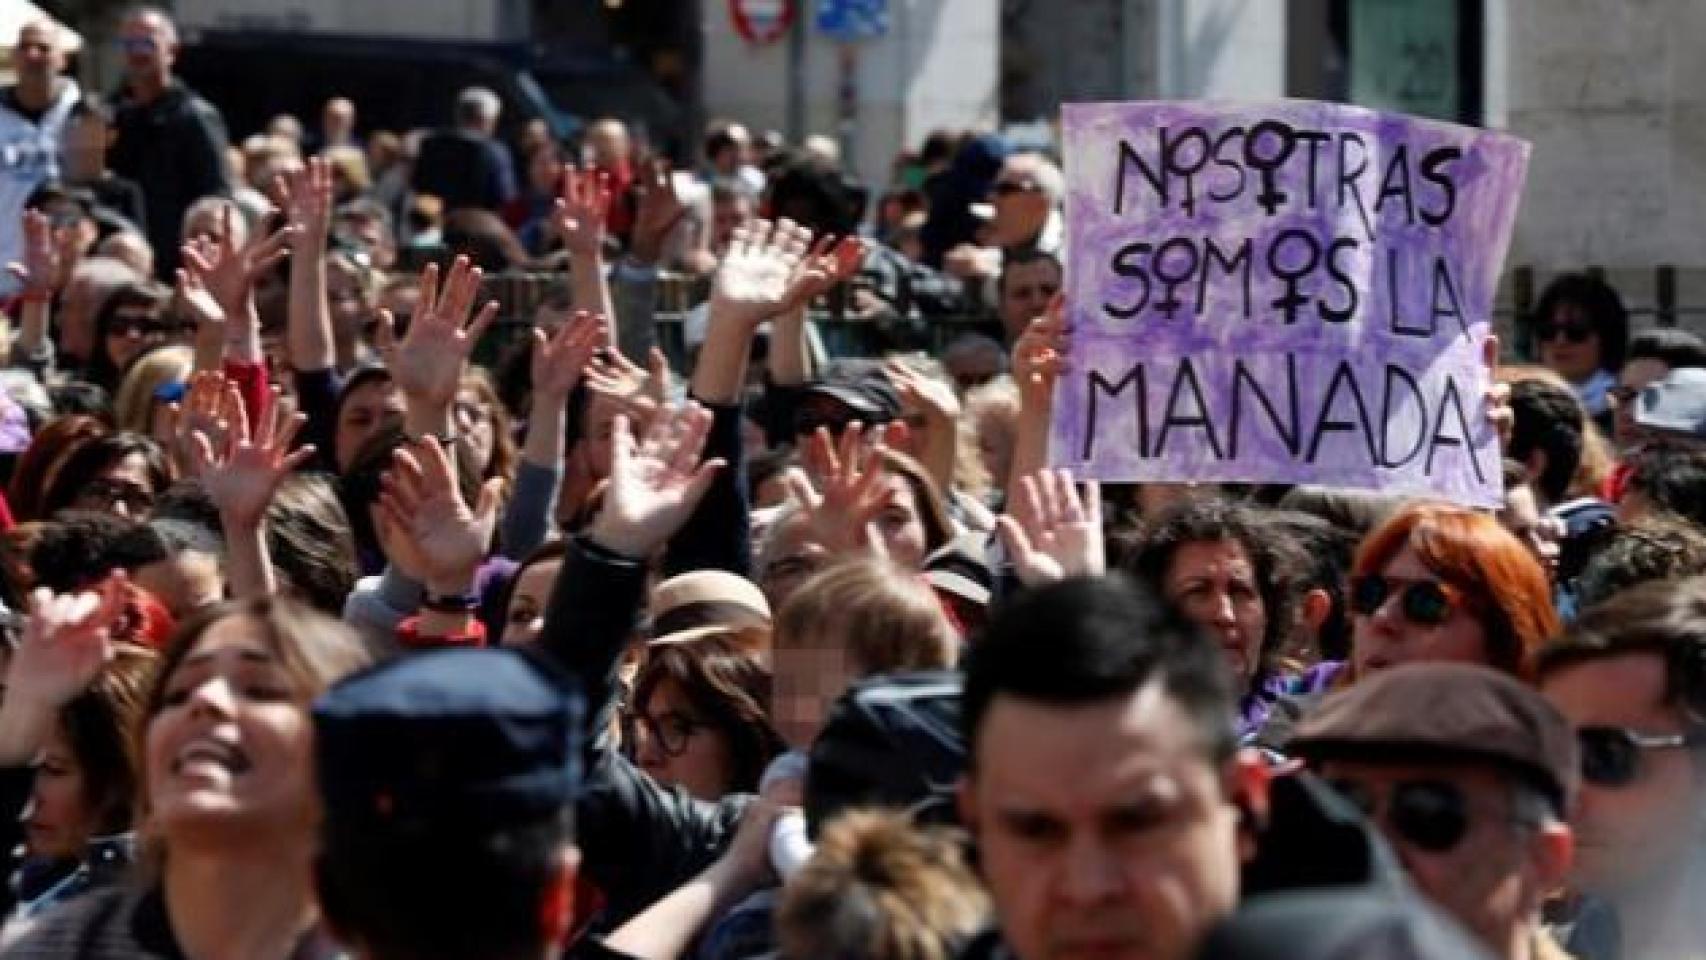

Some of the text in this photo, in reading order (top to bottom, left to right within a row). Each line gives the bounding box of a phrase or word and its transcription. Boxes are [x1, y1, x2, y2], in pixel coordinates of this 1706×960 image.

[1114, 121, 1462, 241] NOSOTRAS
[1104, 229, 1473, 344] SOMOS LA
[1082, 352, 1486, 484] MANADA
